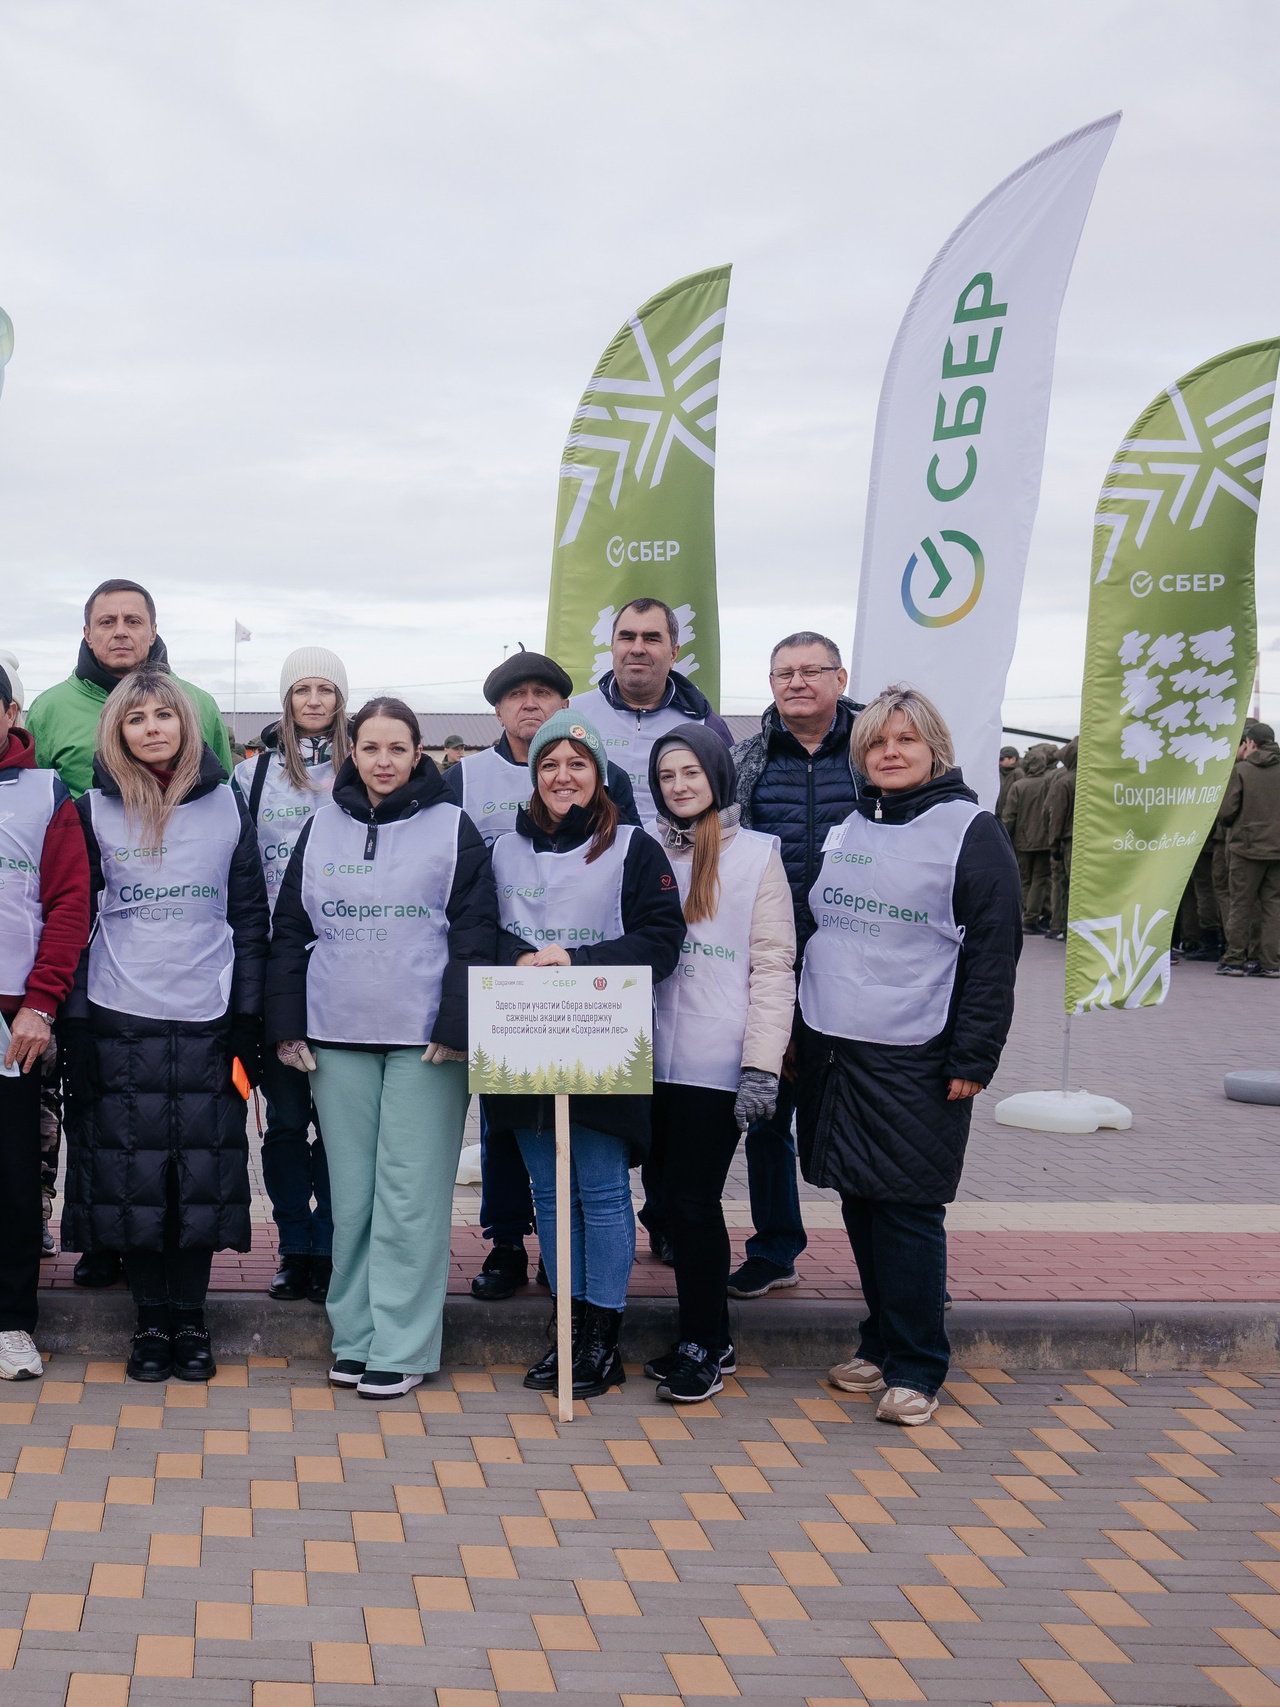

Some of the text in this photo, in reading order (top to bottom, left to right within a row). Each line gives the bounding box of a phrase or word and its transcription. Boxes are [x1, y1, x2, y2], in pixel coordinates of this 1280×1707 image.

[926, 271, 1008, 502] СБЕР
[627, 541, 680, 562] СБЕР
[1159, 574, 1225, 592] СБЕР
[603, 739, 630, 747] БЕР
[1113, 783, 1222, 813] Сохраним лес
[277, 806, 311, 818] СБЕР
[133, 847, 168, 858] СБЕР
[845, 853, 873, 865] СБЕР
[338, 864, 373, 875] СБЕР
[119, 883, 219, 903] Сберегаем
[516, 887, 545, 898] СБЕР
[321, 899, 431, 922] Сберегаем
[823, 887, 929, 925] Сберегаем
[120, 906, 183, 921] вместе
[822, 914, 881, 938] вместе
[324, 927, 388, 941] вместе
[680, 941, 736, 963] егаем
[552, 979, 577, 987] СБЕР
[495, 1000, 622, 1012] Здесь при участии Сбера высажены
[506, 1014, 538, 1022] саженцы
[540, 1014, 566, 1022] акации
[572, 1014, 612, 1024] поддержку
[491, 1024, 628, 1036] Всероссийской акции «Сохраним лес»
